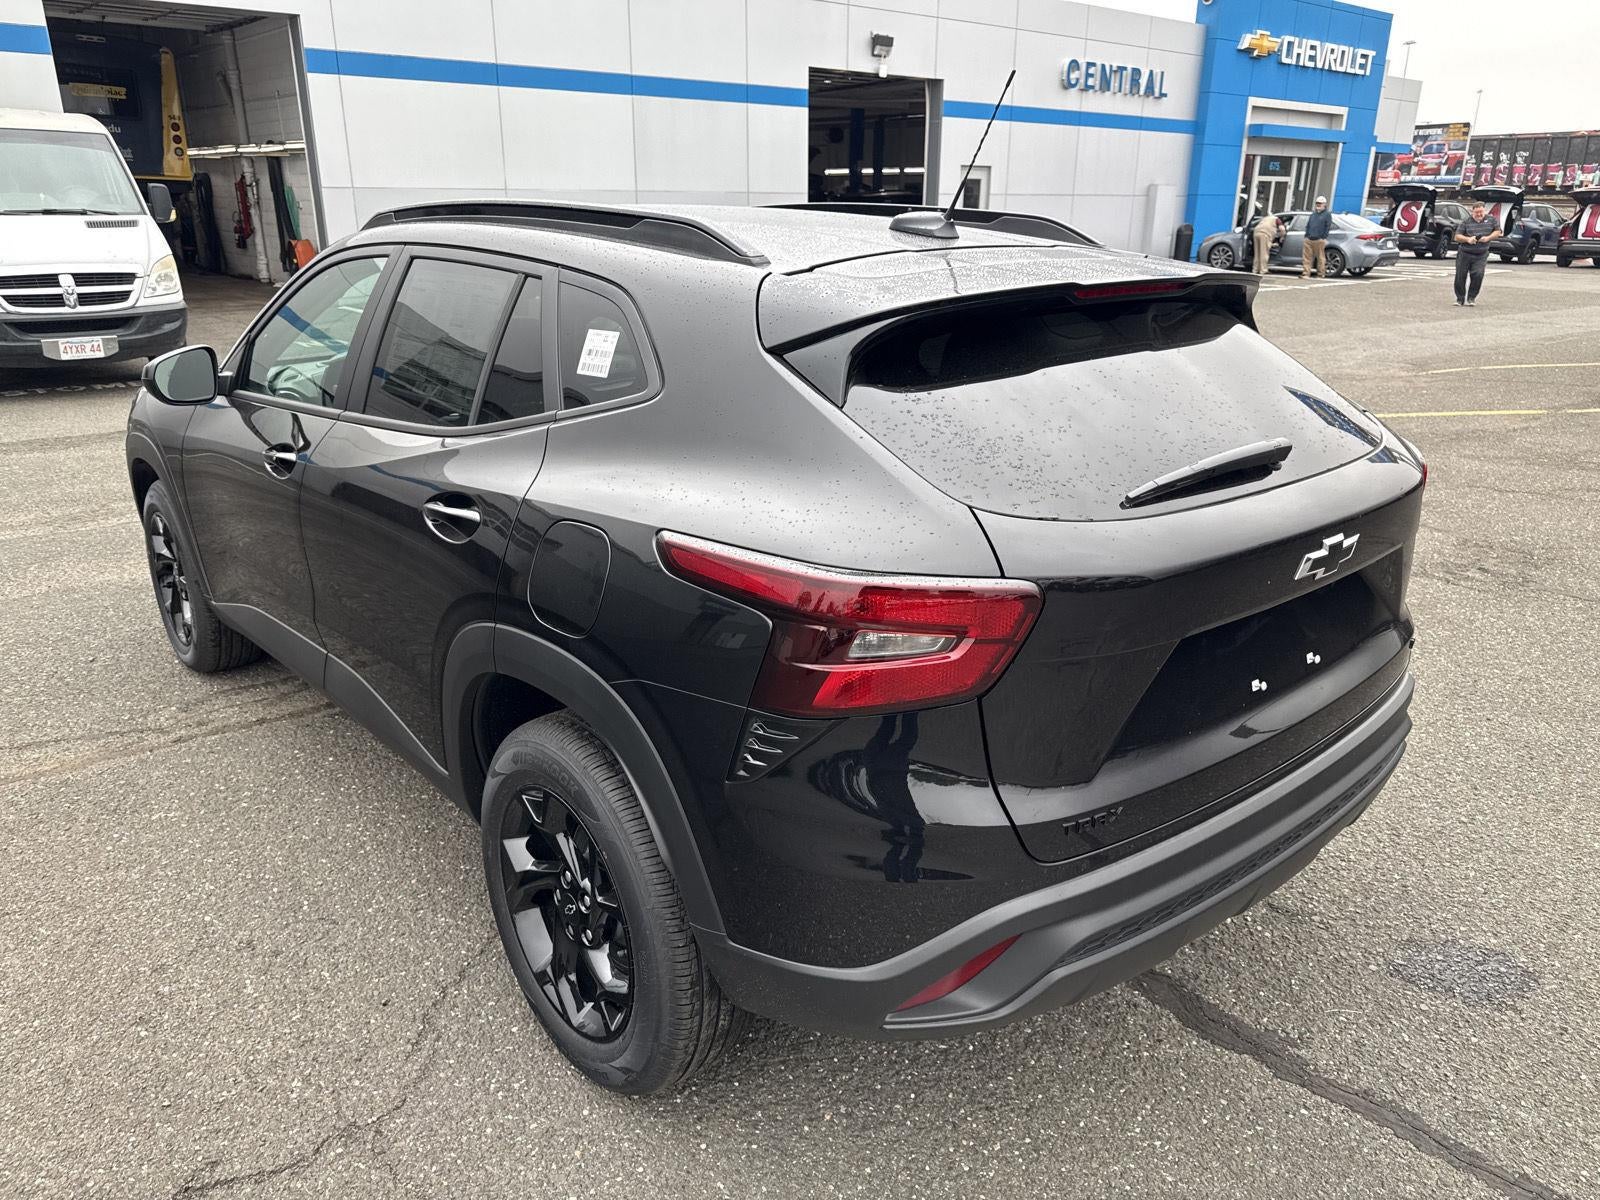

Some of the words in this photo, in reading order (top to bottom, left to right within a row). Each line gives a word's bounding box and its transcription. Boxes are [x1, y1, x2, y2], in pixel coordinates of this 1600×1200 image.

[1281, 35, 1376, 76] CHEVROLET
[1064, 58, 1168, 98] CENTRAL
[1397, 201, 1422, 233] S
[62, 344, 87, 355] 4YXR
[90, 343, 102, 353] 44
